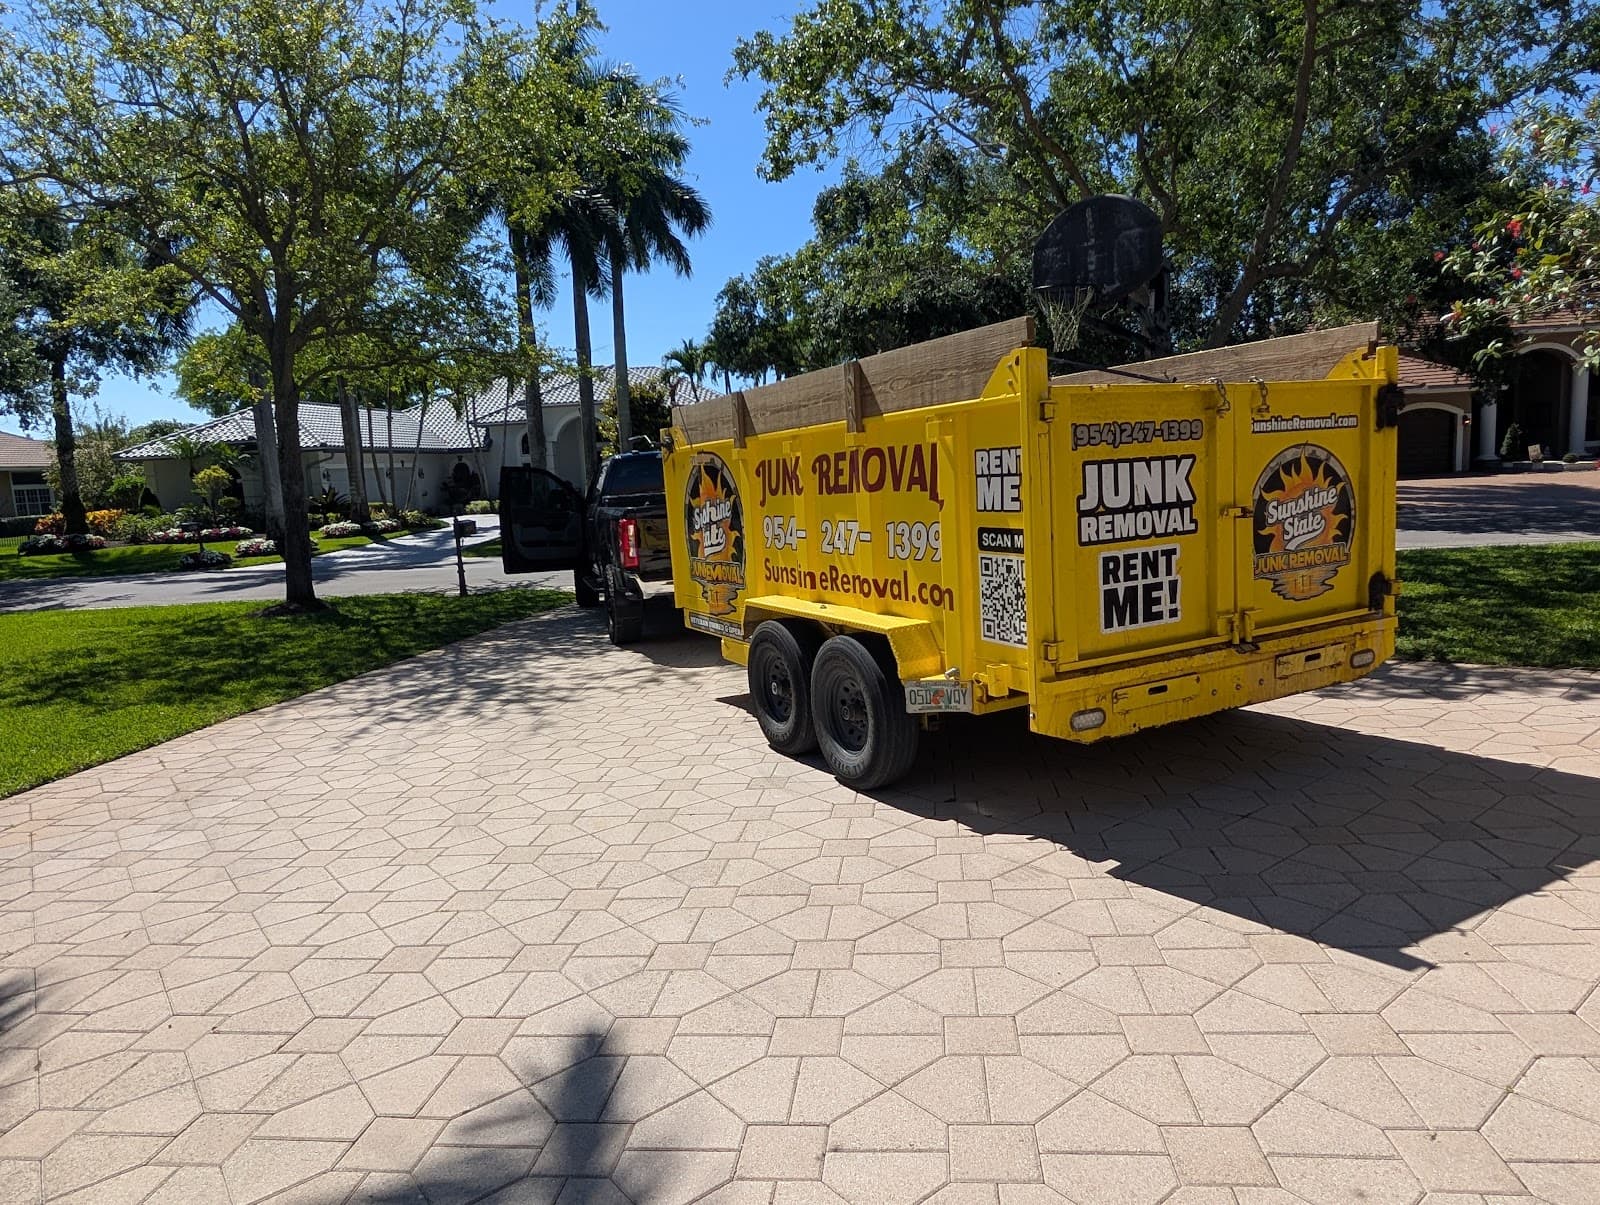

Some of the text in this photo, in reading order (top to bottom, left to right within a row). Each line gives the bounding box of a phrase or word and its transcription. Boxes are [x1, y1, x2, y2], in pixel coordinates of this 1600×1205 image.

[1071, 419, 1203, 451] (954)247-1399
[1251, 412, 1359, 434] unshineRemoval.com
[755, 455, 804, 508] JUNK
[976, 475, 1023, 512] ME
[1079, 456, 1195, 511] JUNK
[1265, 486, 1339, 525] Sunshine
[763, 515, 942, 563] 954- 247- 1399
[981, 532, 1012, 548] SCAN
[1080, 506, 1197, 543] REMOVAL
[1283, 511, 1325, 542] State
[1102, 547, 1177, 586] RENT
[1255, 546, 1347, 576] JUNK REMOVAL
[1103, 579, 1178, 630] ME!
